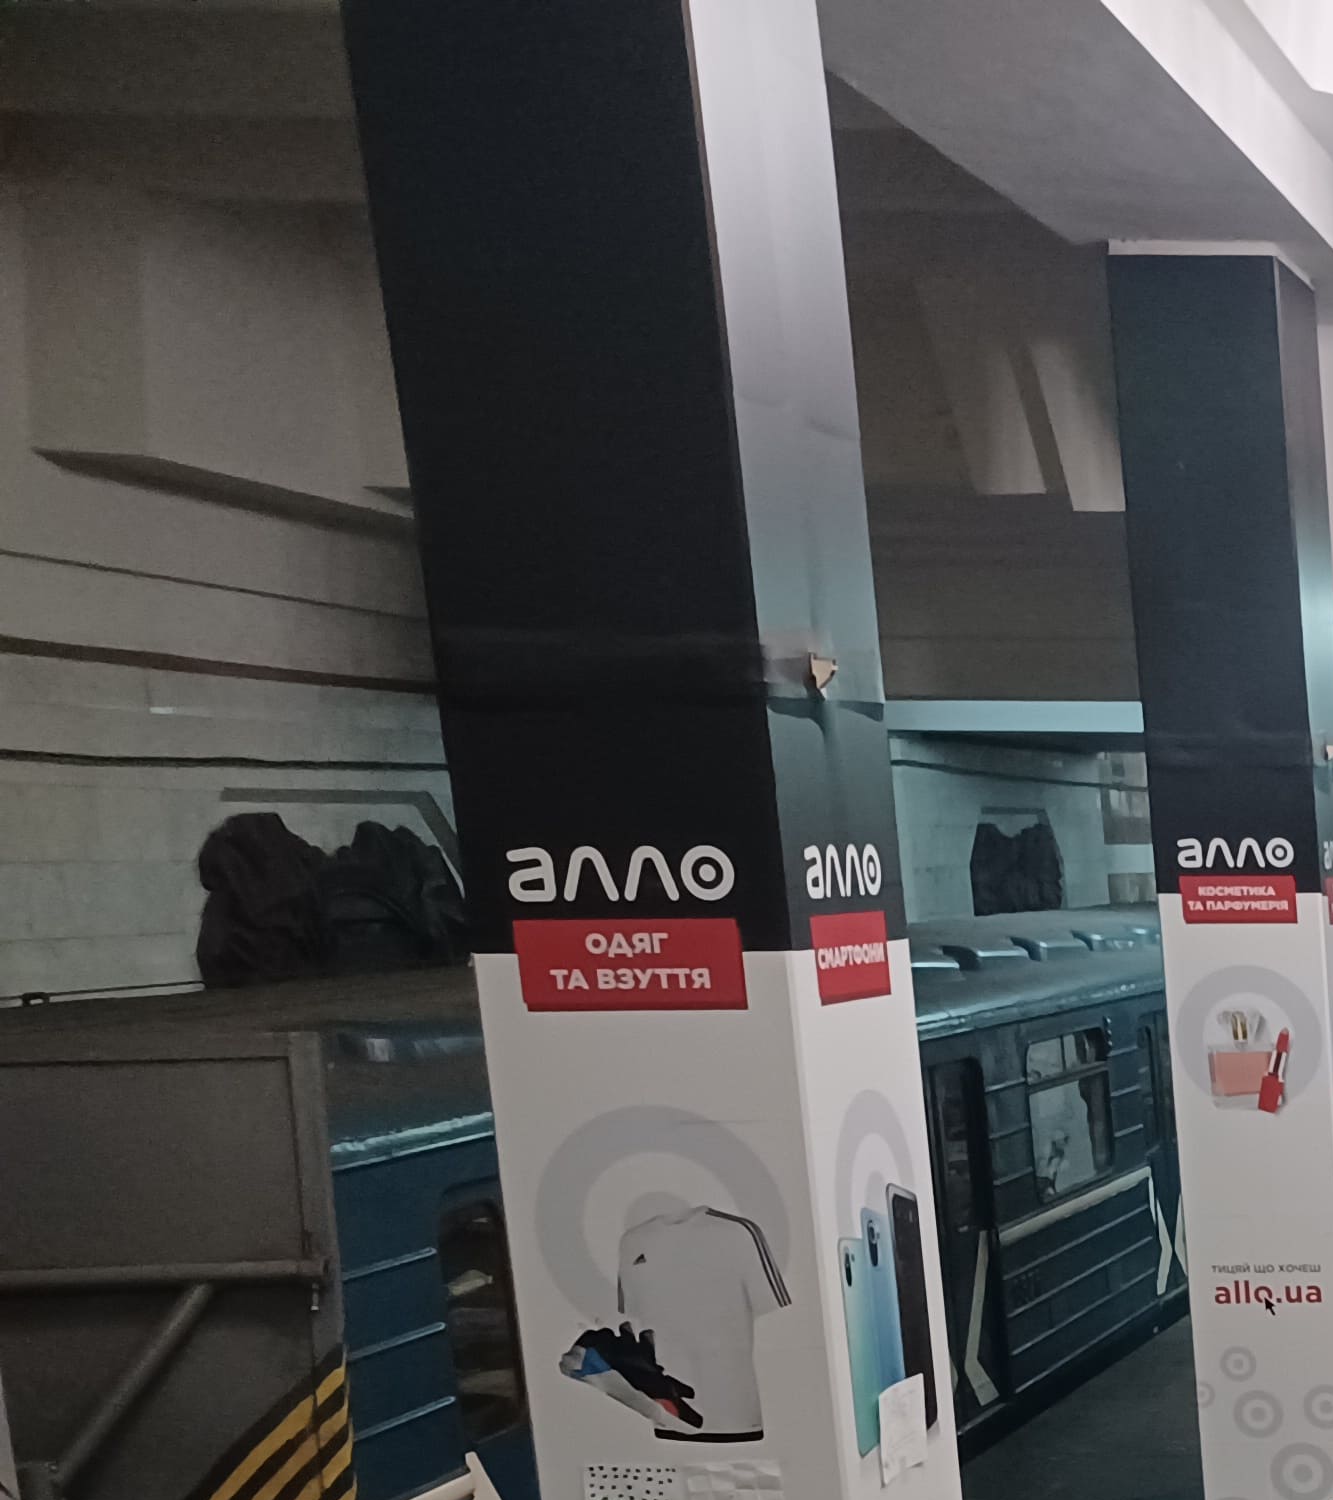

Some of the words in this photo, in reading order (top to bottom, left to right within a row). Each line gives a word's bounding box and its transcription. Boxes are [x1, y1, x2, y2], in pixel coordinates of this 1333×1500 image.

[1176, 837, 1294, 868] алло
[506, 845, 734, 902] алло
[804, 843, 882, 899] алло
[1198, 885, 1276, 897] КОСМЕТИКА
[1187, 901, 1204, 911] ТА
[585, 932, 668, 958] ОДЯГ
[818, 942, 885, 970] СМАРТФОНИ
[550, 968, 589, 990] ТА
[597, 967, 711, 990] ВЗУТТЯ
[1214, 1280, 1323, 1304] allo.ua
